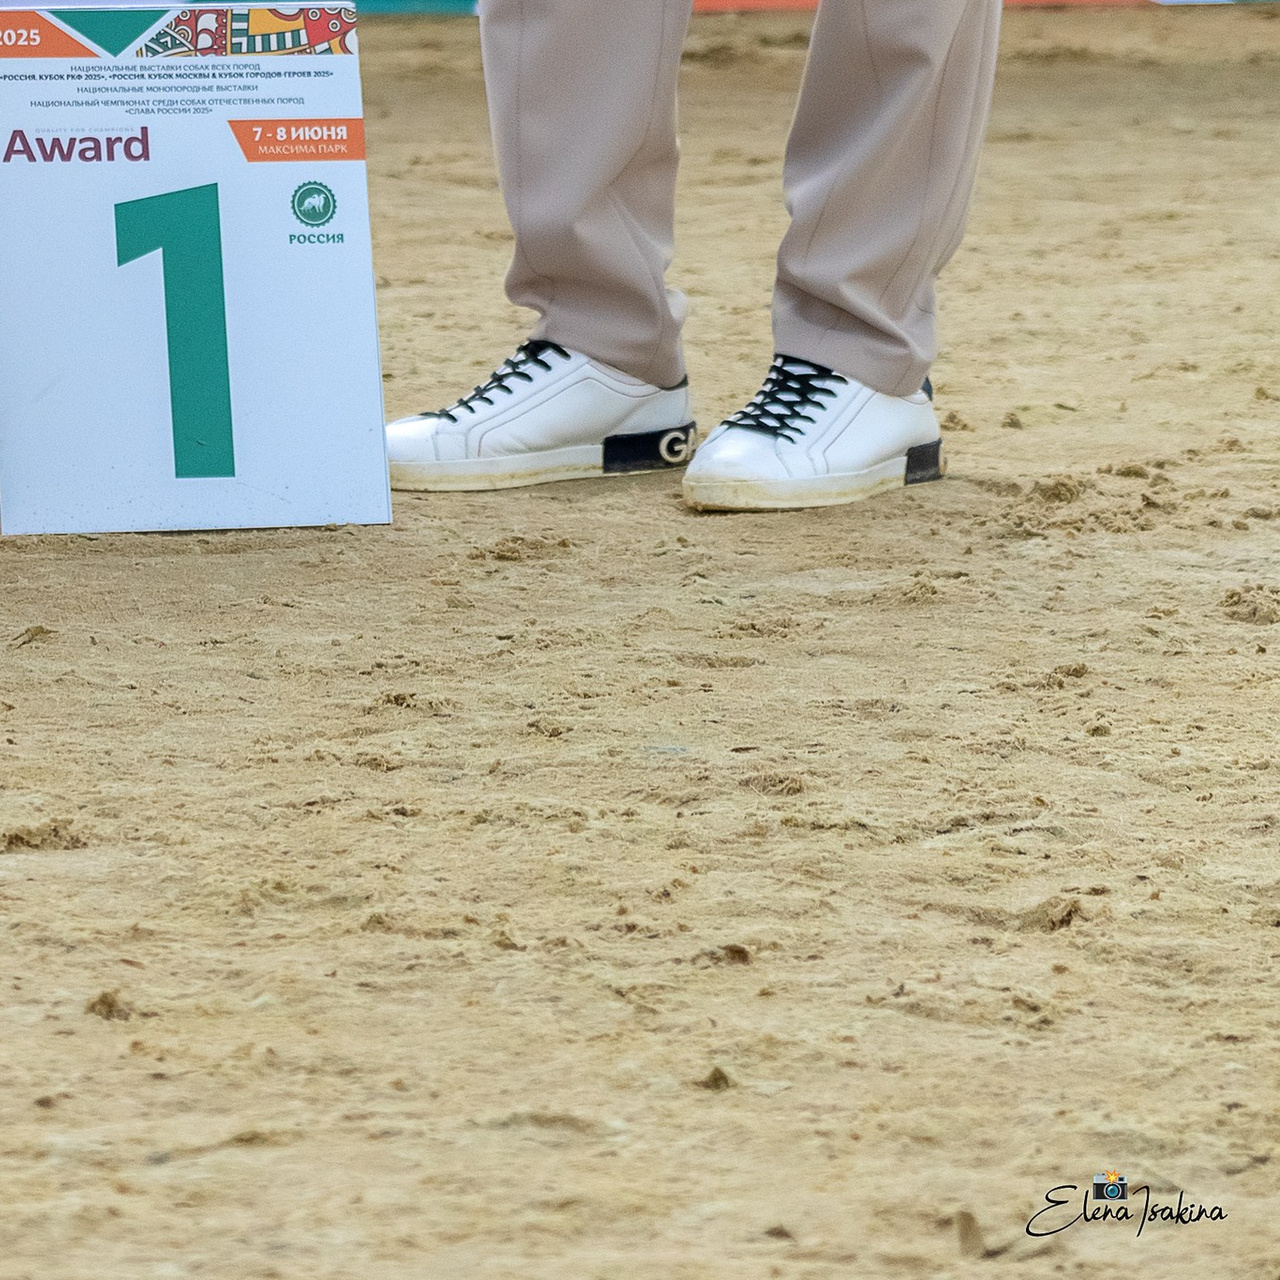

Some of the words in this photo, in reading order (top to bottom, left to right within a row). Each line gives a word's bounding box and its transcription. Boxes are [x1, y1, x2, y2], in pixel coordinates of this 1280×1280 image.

[70, 65, 137, 73] НАЦИОНАЛЬНЫЕ
[77, 86, 144, 94] НАЦИОНАЛЬНЫЕ
[146, 85, 213, 93] МОНОПОРОДНЫЕ
[30, 99, 100, 108] НАЦИОНАЛЬНЫЙ
[152, 99, 179, 107] СРЕДИ
[208, 98, 276, 106] ОТЕЧЕСТВЕННЫХ
[252, 127, 263, 141] 7
[276, 127, 287, 141] 8
[290, 125, 348, 141] ИЮНЯ
[2, 126, 150, 163] Award
[258, 145, 316, 155] МАКСИМА
[318, 144, 348, 154] ПАРК
[289, 233, 345, 245] РОССИЯ
[114, 182, 235, 478] 1
